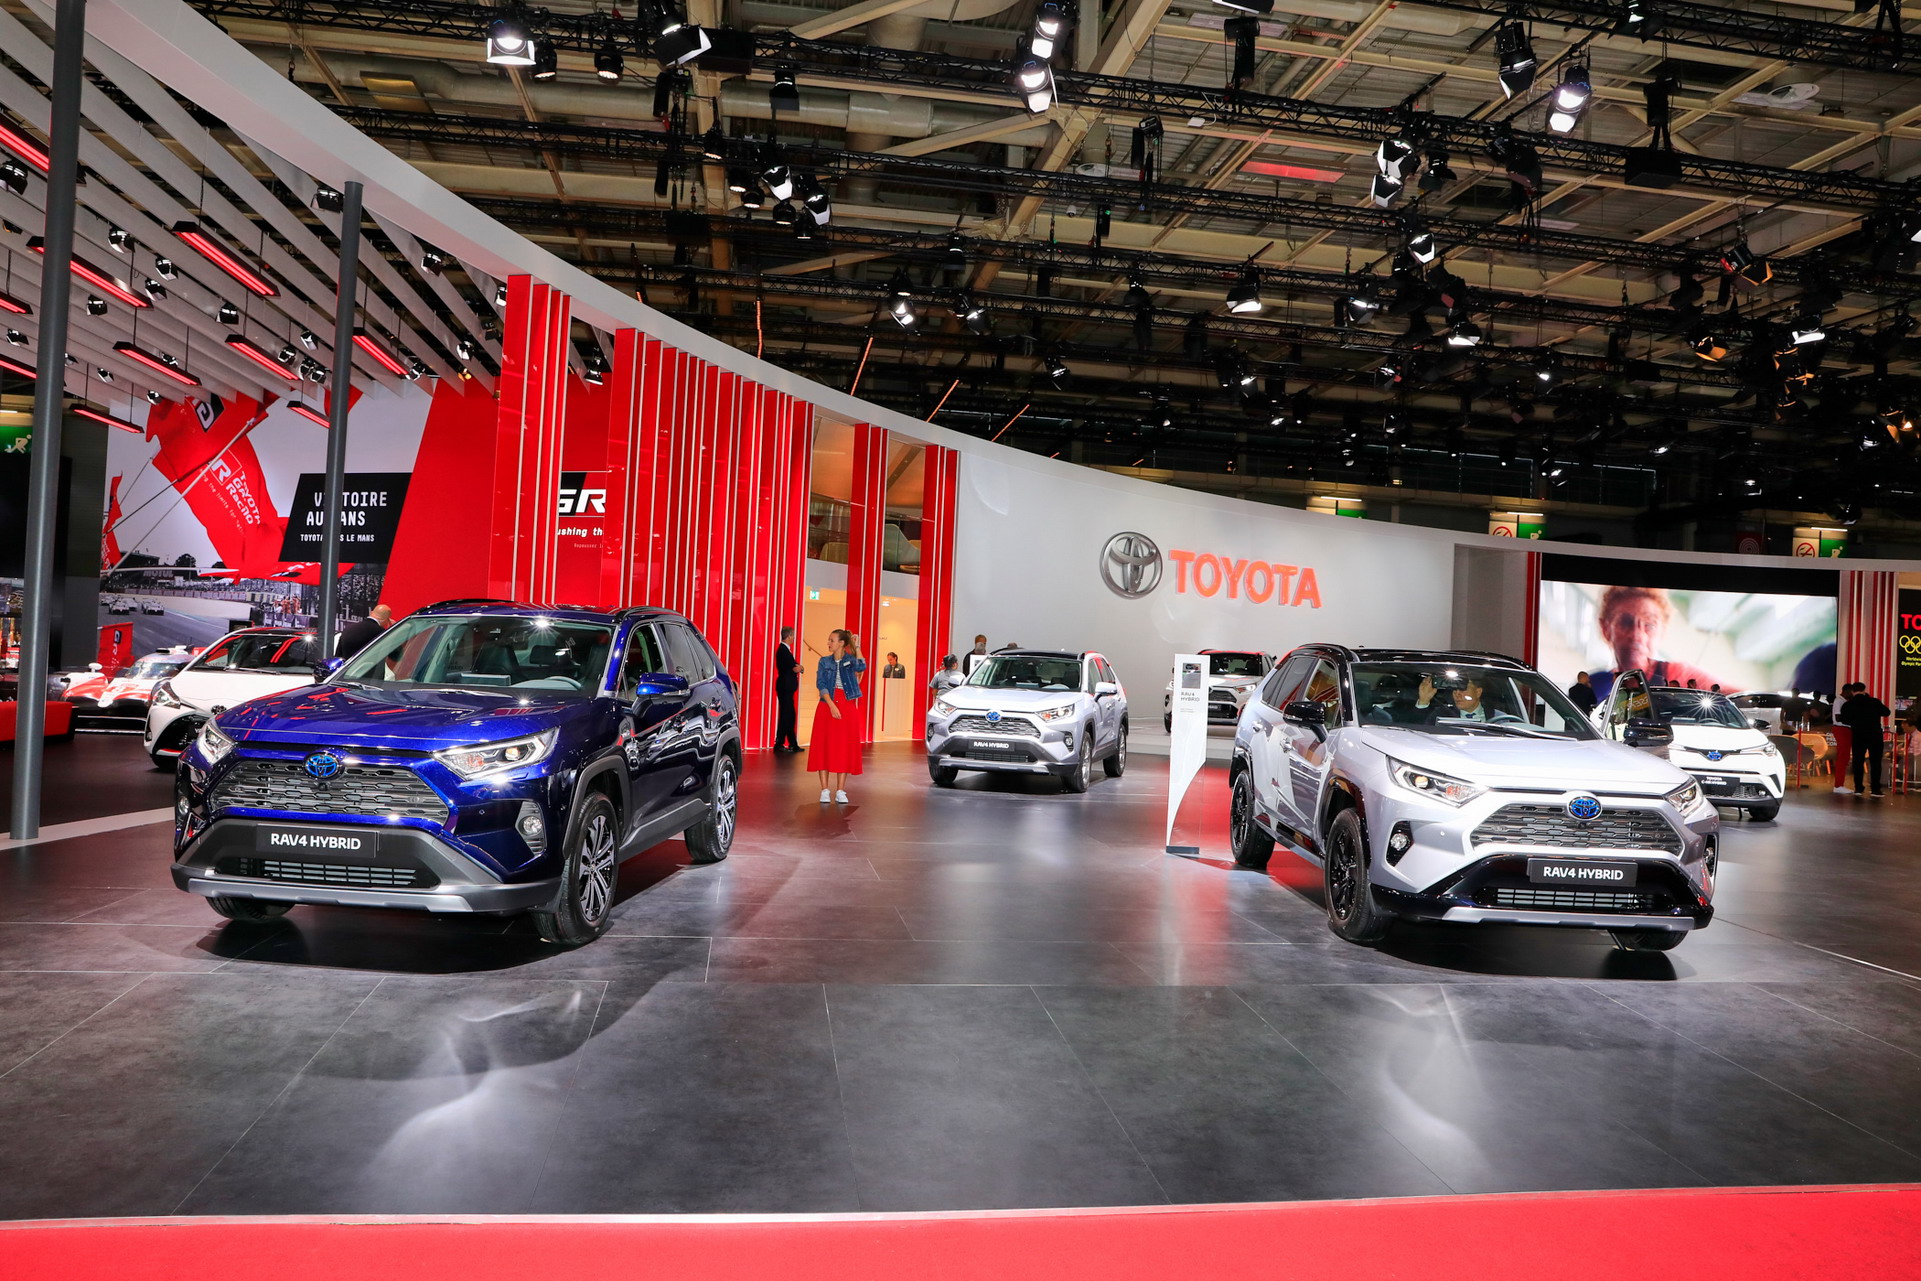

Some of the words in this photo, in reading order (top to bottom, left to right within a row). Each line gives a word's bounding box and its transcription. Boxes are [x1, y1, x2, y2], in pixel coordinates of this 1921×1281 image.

[211, 458, 231, 482] R
[314, 492, 388, 507] VTOIRE
[340, 511, 366, 526] ANS
[557, 527, 588, 537] ushing
[593, 527, 604, 536] th
[1169, 549, 1322, 609] TOYOTA
[270, 833, 308, 847] RAV4
[310, 836, 362, 850] HYBRID
[1543, 866, 1576, 878] RAV4
[1578, 868, 1624, 880] HYBRID
